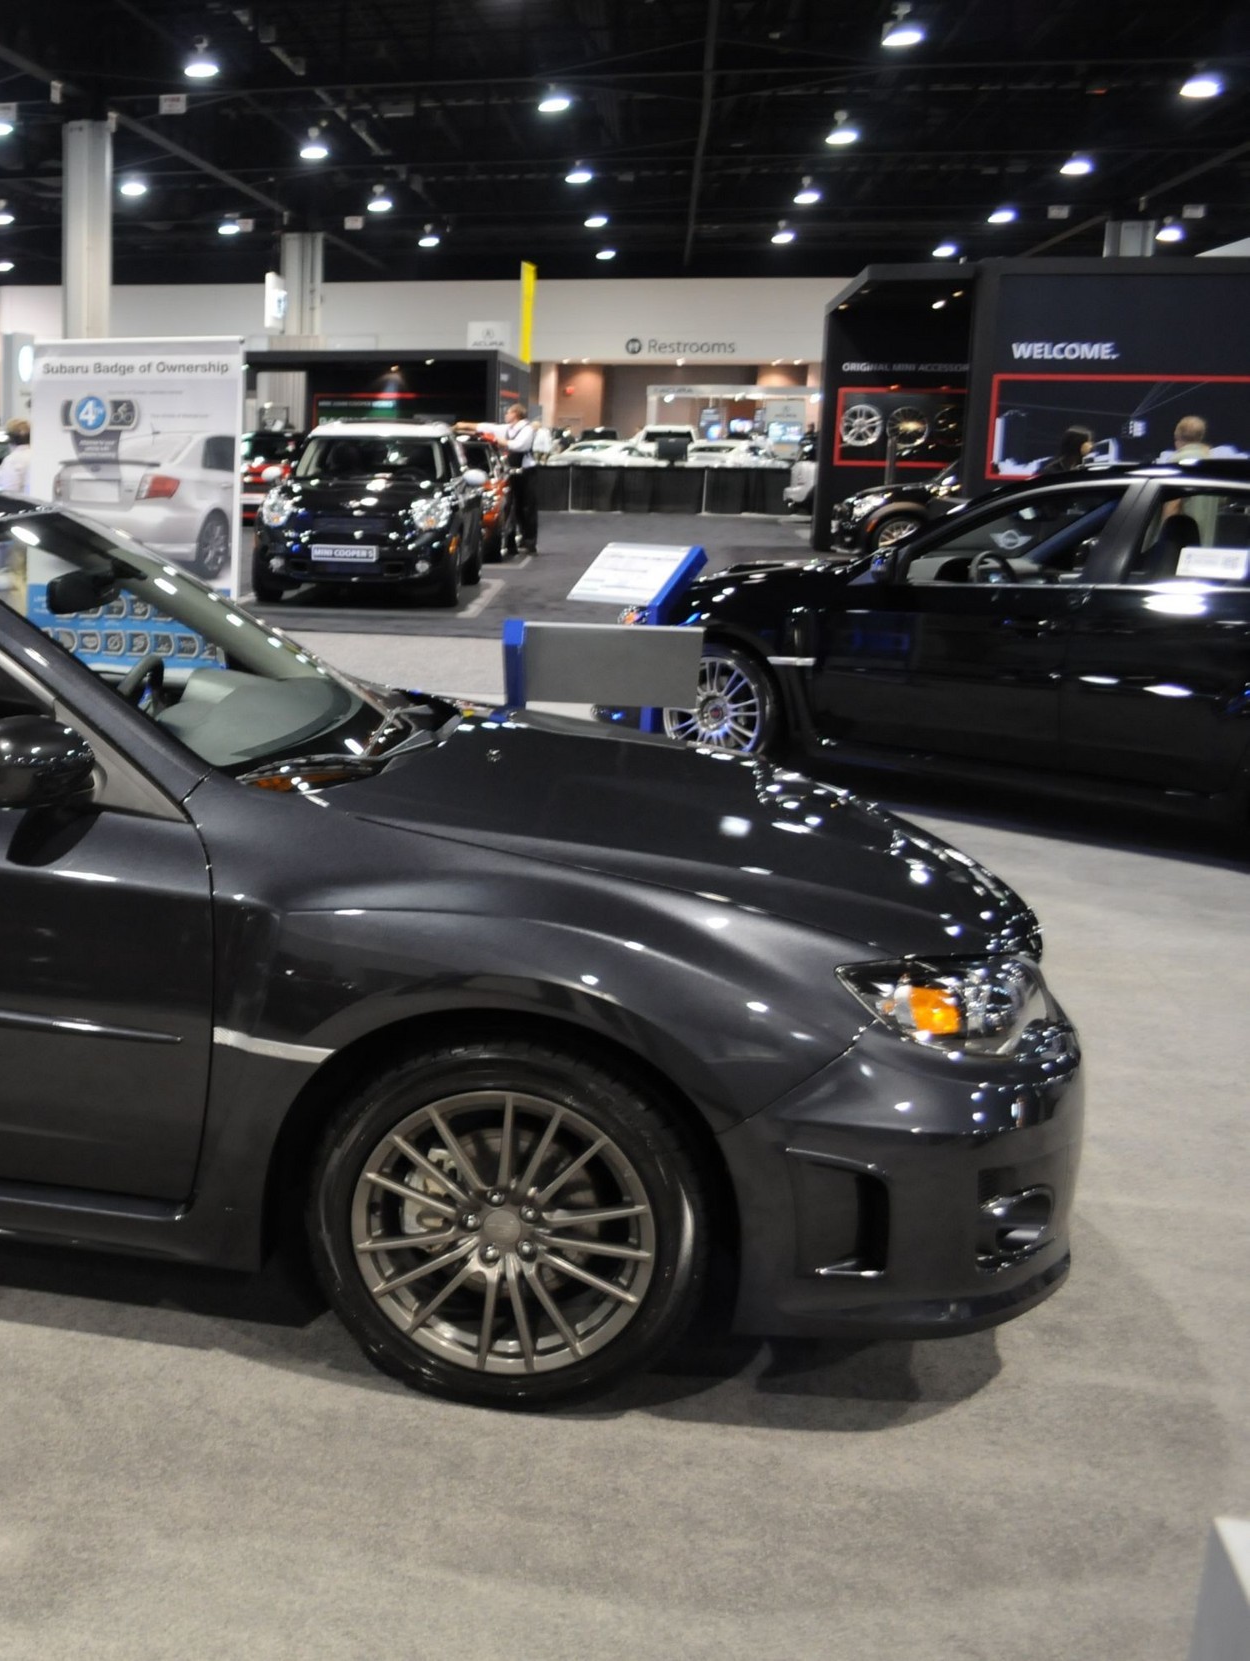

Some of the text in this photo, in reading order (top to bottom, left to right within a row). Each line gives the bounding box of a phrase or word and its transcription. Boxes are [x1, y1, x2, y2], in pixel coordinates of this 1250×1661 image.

[648, 339, 736, 354] Restrooms
[1011, 341, 1121, 360] WELCOME.
[43, 361, 229, 376] Subaru Badge of Ownership
[841, 361, 890, 373] ORIGINAL
[892, 362, 917, 372] MINI
[314, 548, 333, 557] MINI
[334, 548, 367, 558] COOPER
